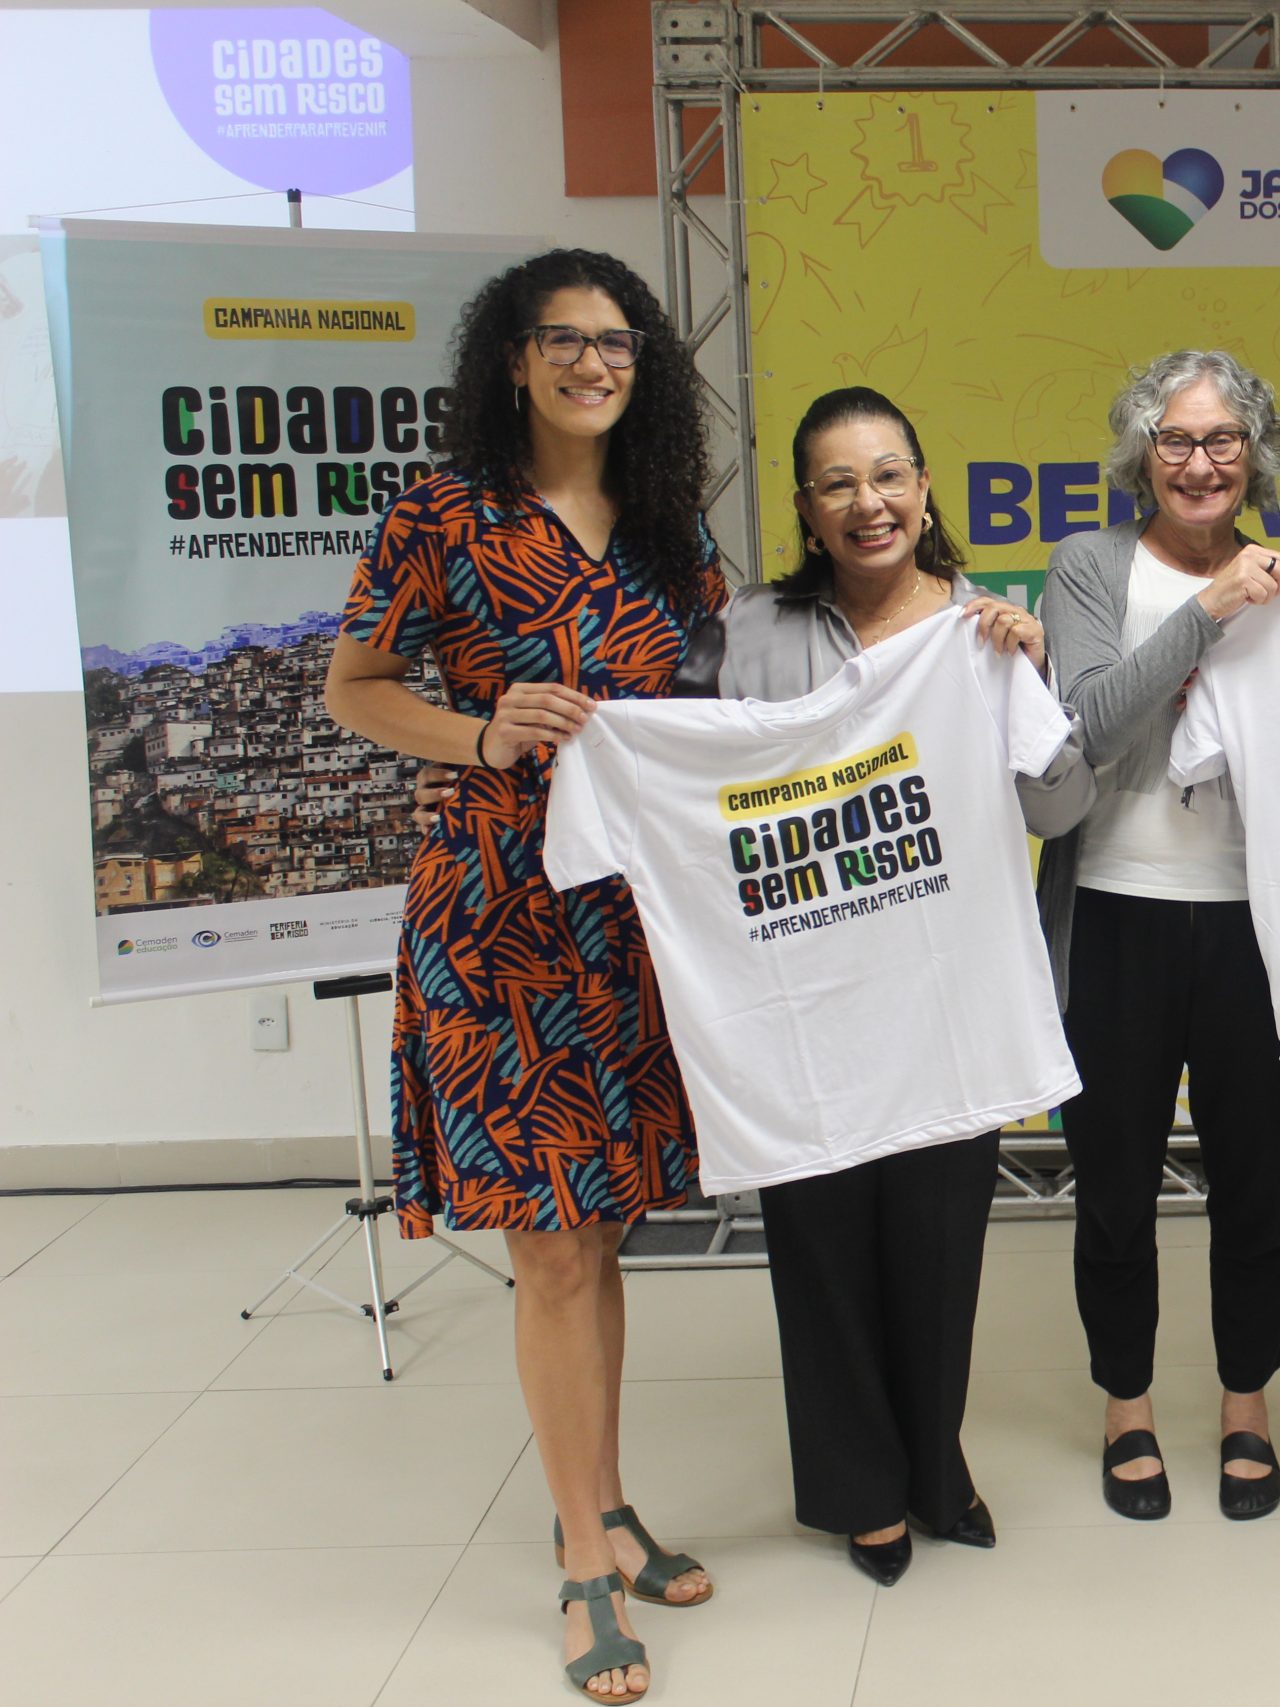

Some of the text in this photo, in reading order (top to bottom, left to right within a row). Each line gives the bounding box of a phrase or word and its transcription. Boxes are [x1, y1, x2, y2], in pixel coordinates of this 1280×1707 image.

[214, 307, 405, 330] CAMPANHA NACIONAL
[749, 873, 951, 942] #APRENDERPARAPREVENIR
[270, 920, 307, 931] PERIFERIA
